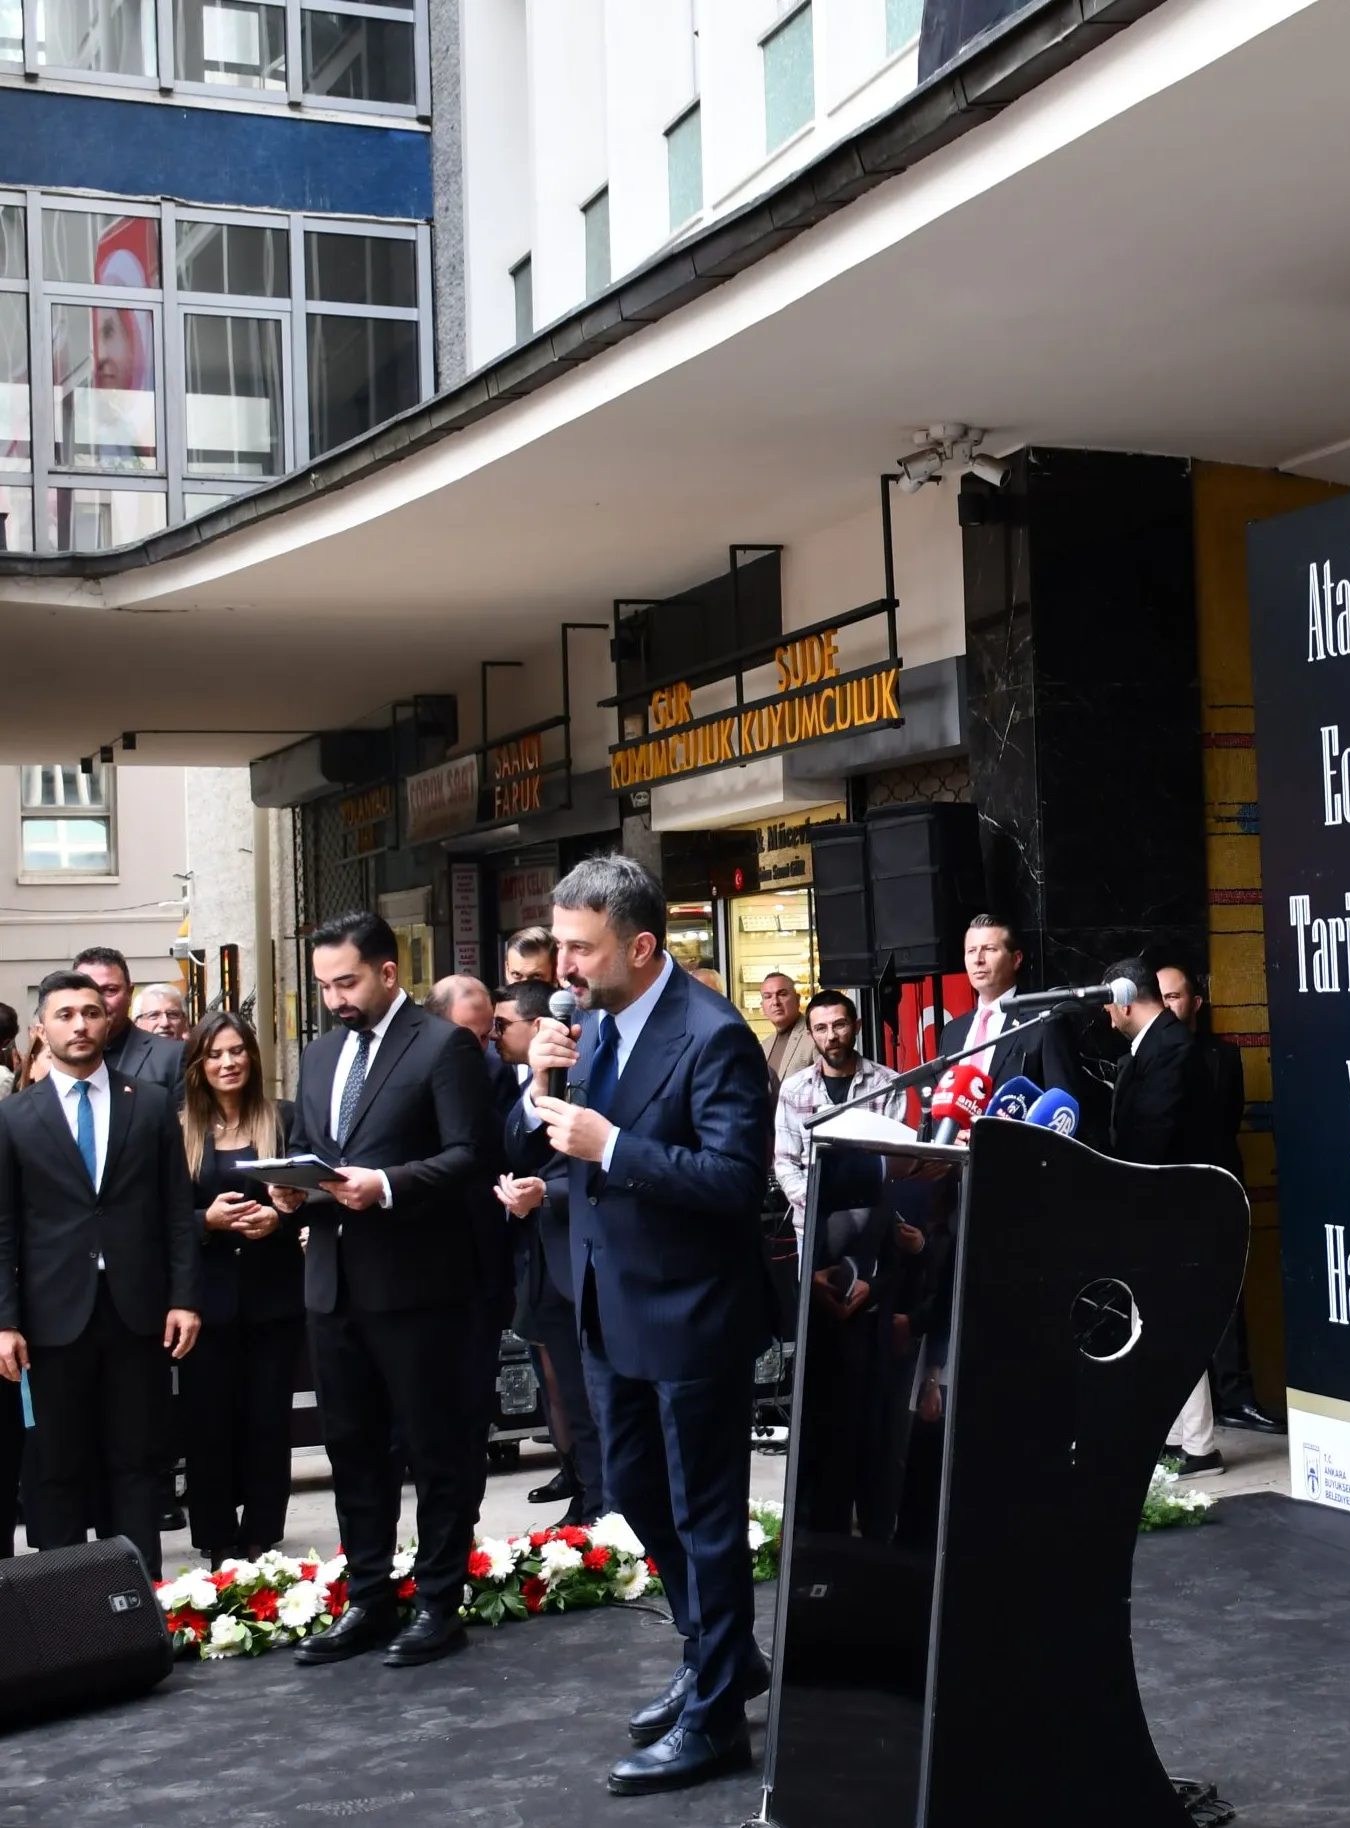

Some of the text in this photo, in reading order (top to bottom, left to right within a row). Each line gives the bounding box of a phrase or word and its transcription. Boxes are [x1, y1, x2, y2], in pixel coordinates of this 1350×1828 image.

[775, 628, 841, 693] SUDE
[741, 668, 899, 755] KUYUMCULUK
[611, 716, 738, 790] KUYUMCULUK
[494, 774, 541, 820] FARUK
[1324, 1466, 1347, 1480] ANKARA
